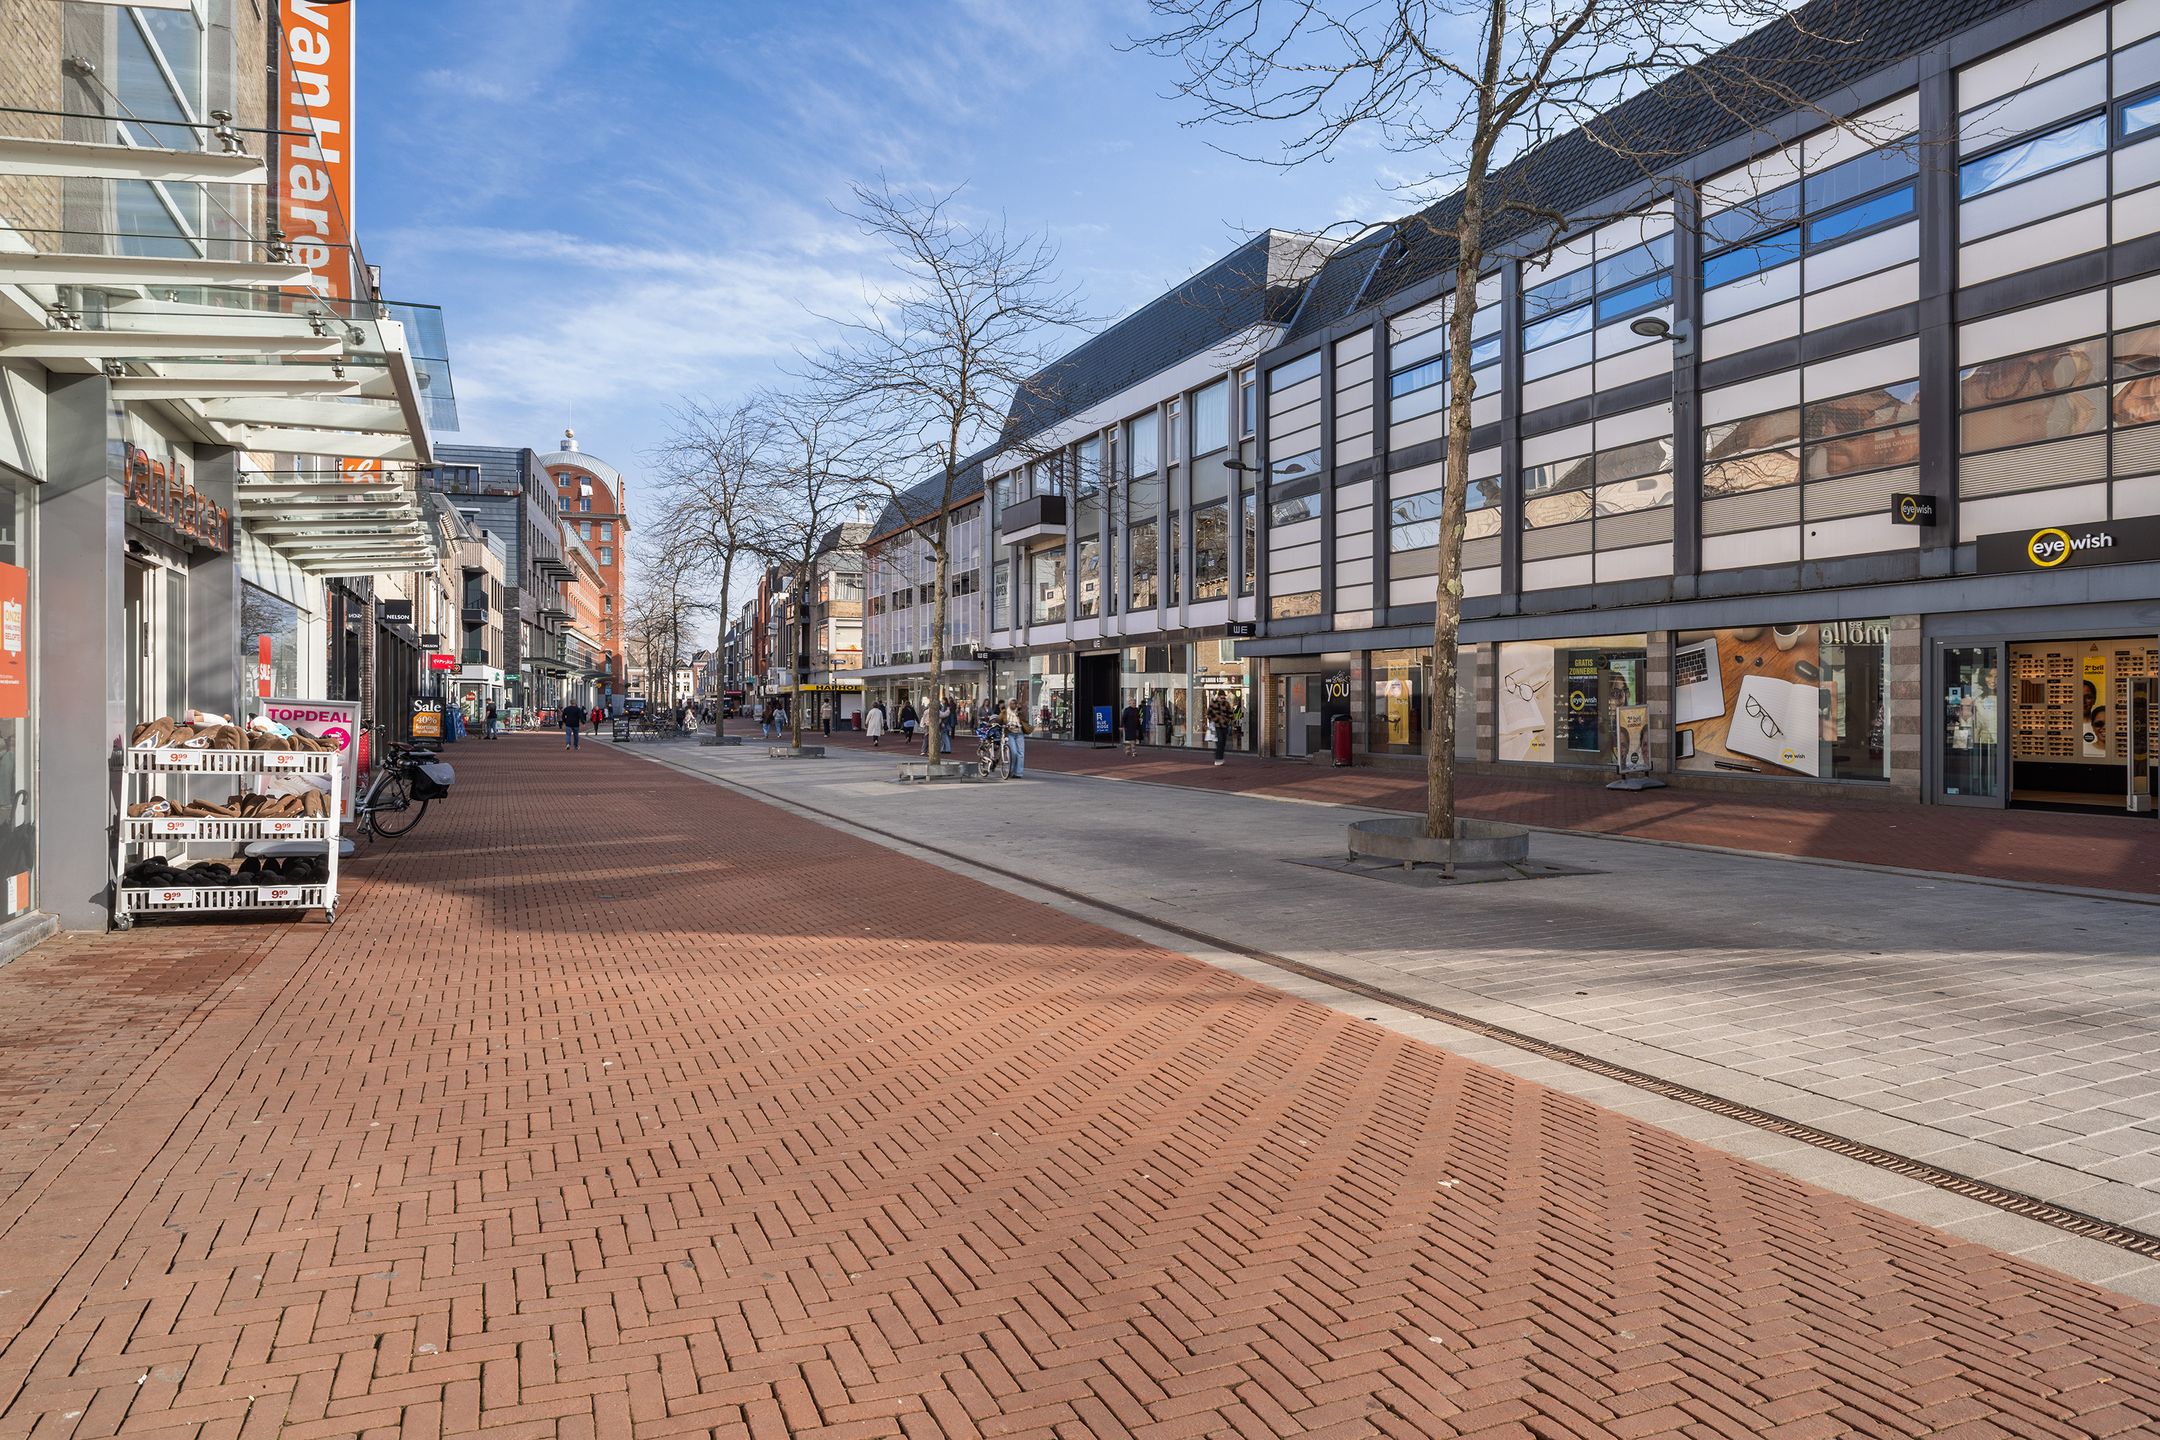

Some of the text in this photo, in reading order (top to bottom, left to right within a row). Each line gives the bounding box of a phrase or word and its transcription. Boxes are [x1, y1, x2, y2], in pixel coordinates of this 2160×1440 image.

[1233, 625, 1248, 634] WE
[1574, 658, 1594, 667] GRATIS
[259, 663, 271, 681] SALE
[1569, 667, 1598, 676] ZONNEBRIL
[413, 699, 442, 713] Sale
[268, 708, 353, 723] TOPDEAL
[416, 715, 438, 725] 40%
